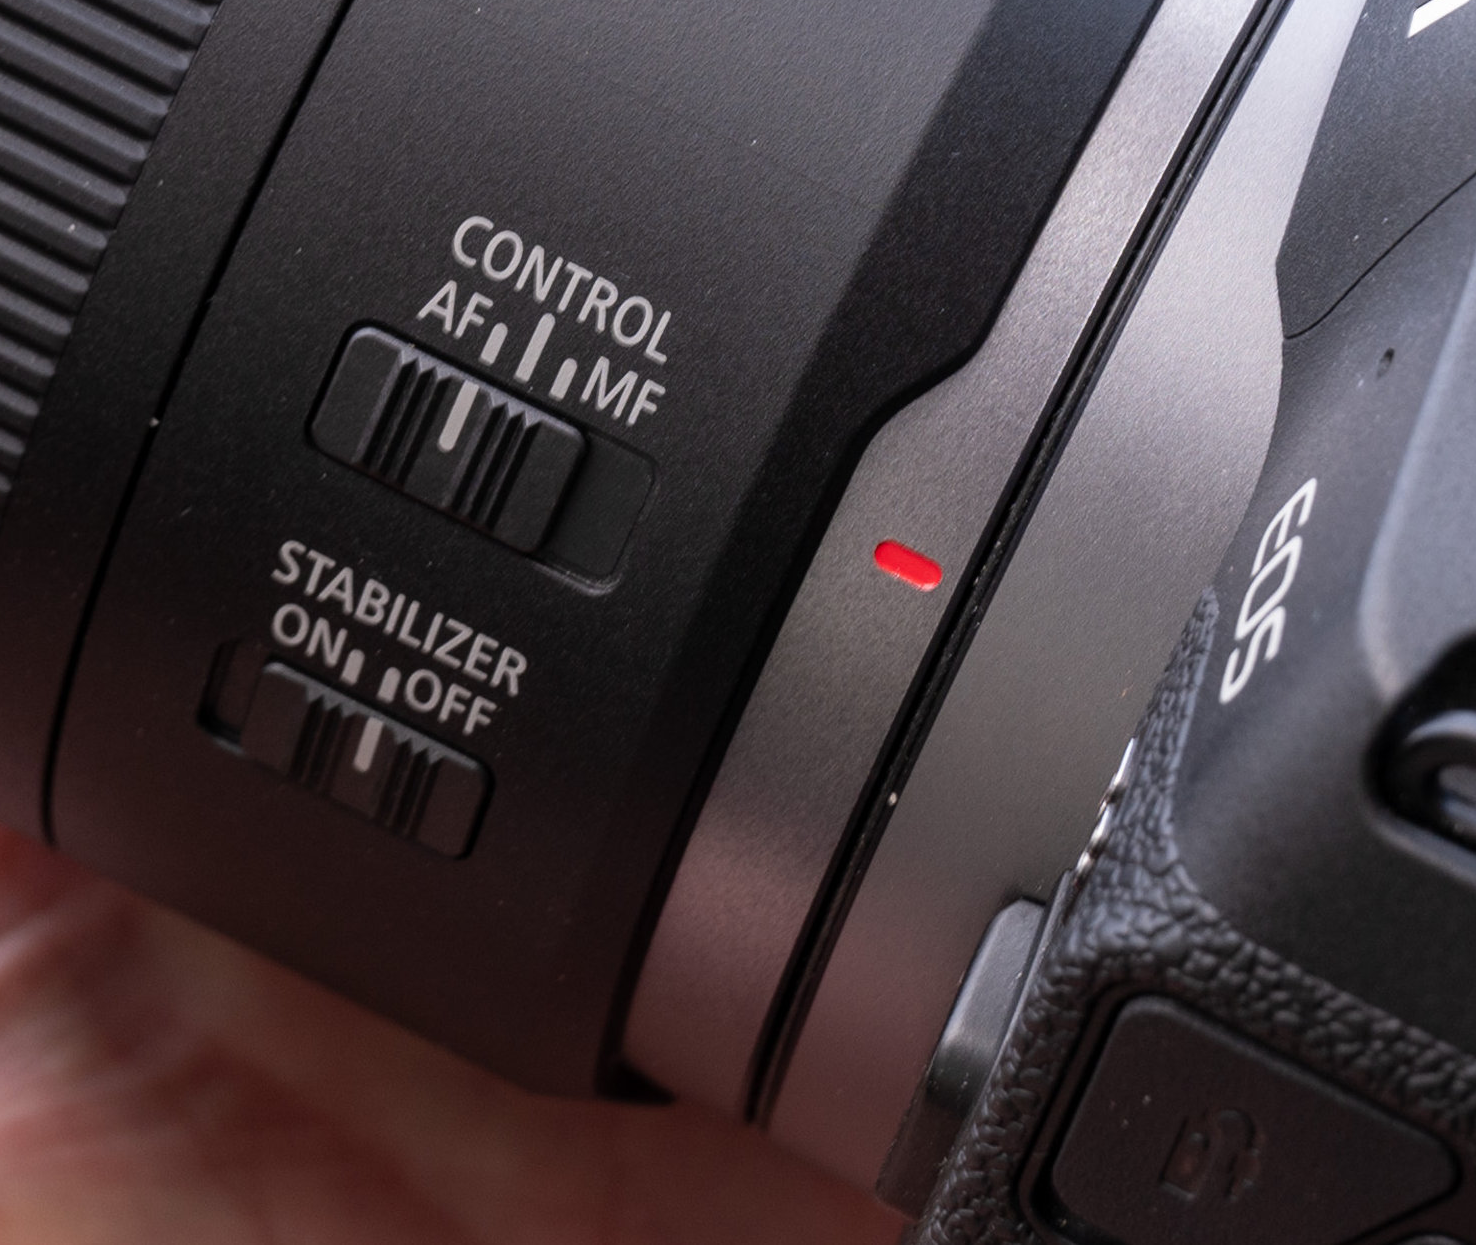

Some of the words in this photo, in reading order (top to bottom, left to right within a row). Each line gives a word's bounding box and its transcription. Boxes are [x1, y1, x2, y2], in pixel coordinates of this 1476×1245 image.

[417, 280, 493, 338] AF
[581, 357, 666, 426] MF
[451, 215, 673, 365] CONTROL
[270, 539, 528, 696] STABILIZER
[1219, 477, 1317, 704] EOS
[271, 602, 346, 667] ON
[403, 668, 496, 735] OFF
